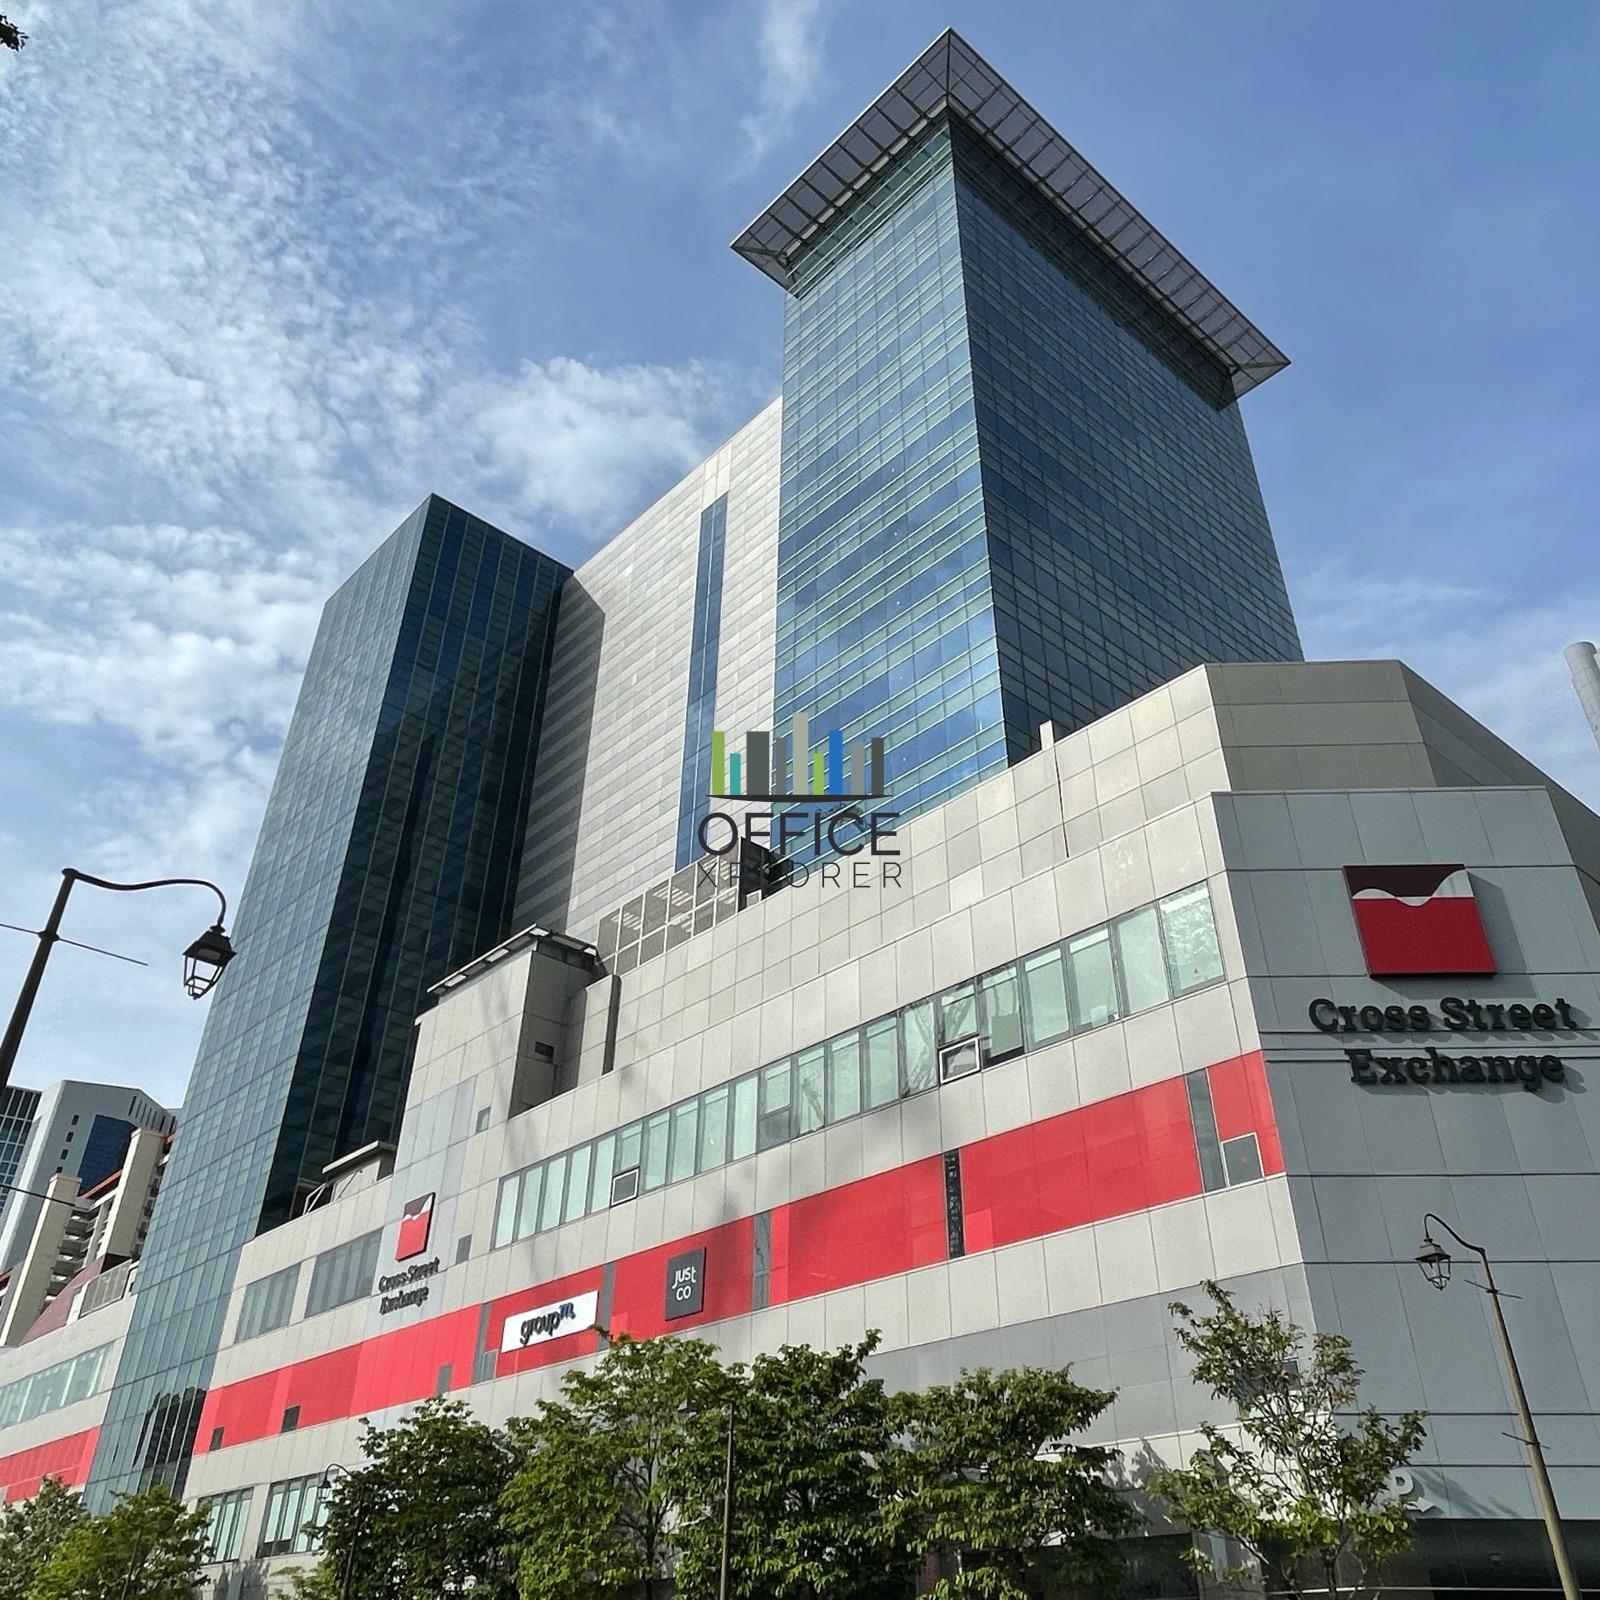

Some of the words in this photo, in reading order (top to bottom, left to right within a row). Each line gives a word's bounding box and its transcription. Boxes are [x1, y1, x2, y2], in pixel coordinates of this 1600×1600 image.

[1308, 998, 1432, 1032] Cross
[1439, 997, 1577, 1030] Street
[1344, 1046, 1566, 1092] Exchange
